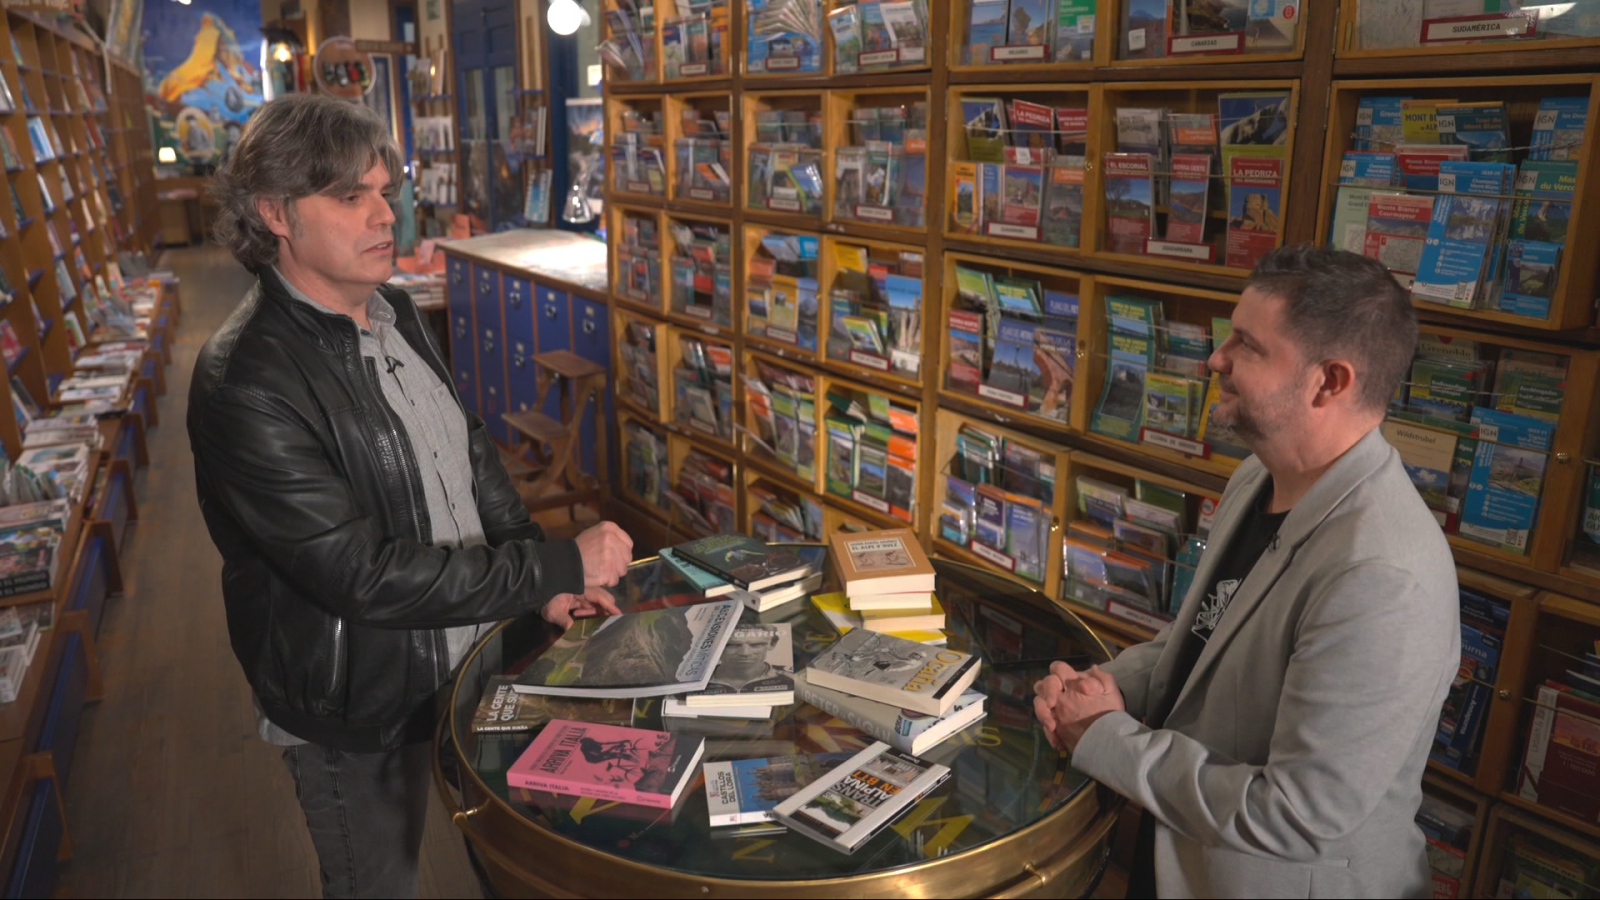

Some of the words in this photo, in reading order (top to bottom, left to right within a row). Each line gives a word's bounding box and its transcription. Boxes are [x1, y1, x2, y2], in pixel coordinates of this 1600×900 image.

[1452, 22, 1501, 34] SUDAMÉRICA
[1358, 111, 1372, 120] IGN
[1405, 113, 1427, 122] MONT
[1537, 115, 1556, 124] IGN
[1438, 119, 1455, 128] IGN
[1118, 161, 1148, 170] ESCORIAL
[1233, 168, 1244, 177] LA
[1244, 169, 1278, 178] PEDRIZA
[1439, 178, 1455, 187] IGN
[1517, 175, 1536, 184] IGN
[1558, 175, 1576, 184] Mas
[1540, 182, 1551, 191] du
[1377, 203, 1397, 211] Monte
[1397, 205, 1420, 214] Bianco
[1378, 210, 1417, 220] Courmayeur
[1421, 342, 1472, 358] Grenoble
[1396, 429, 1437, 444] Wildstrubel
[1480, 426, 1498, 437] IGN
[699, 603, 732, 651] ASCENSIONES
[903, 649, 965, 693] Ocaña
[490, 684, 509, 710] GENTE
[486, 710, 501, 722] LA
[500, 704, 515, 722] QUE
[803, 689, 840, 716] PETER
[847, 712, 891, 742] SAGAN
[540, 741, 567, 775] ARRIVA
[562, 726, 588, 751] ITALIA
[724, 771, 735, 791] LOIRA
[851, 769, 881, 786] BTT
[525, 780, 548, 789] ARRIVA
[549, 784, 570, 792] ITALIA
[717, 770, 729, 805] CASTILLOS
[843, 774, 895, 801] ALPINA
[879, 782, 903, 796] EN
[728, 788, 737, 803] DEL
[830, 782, 881, 808] TRANS
